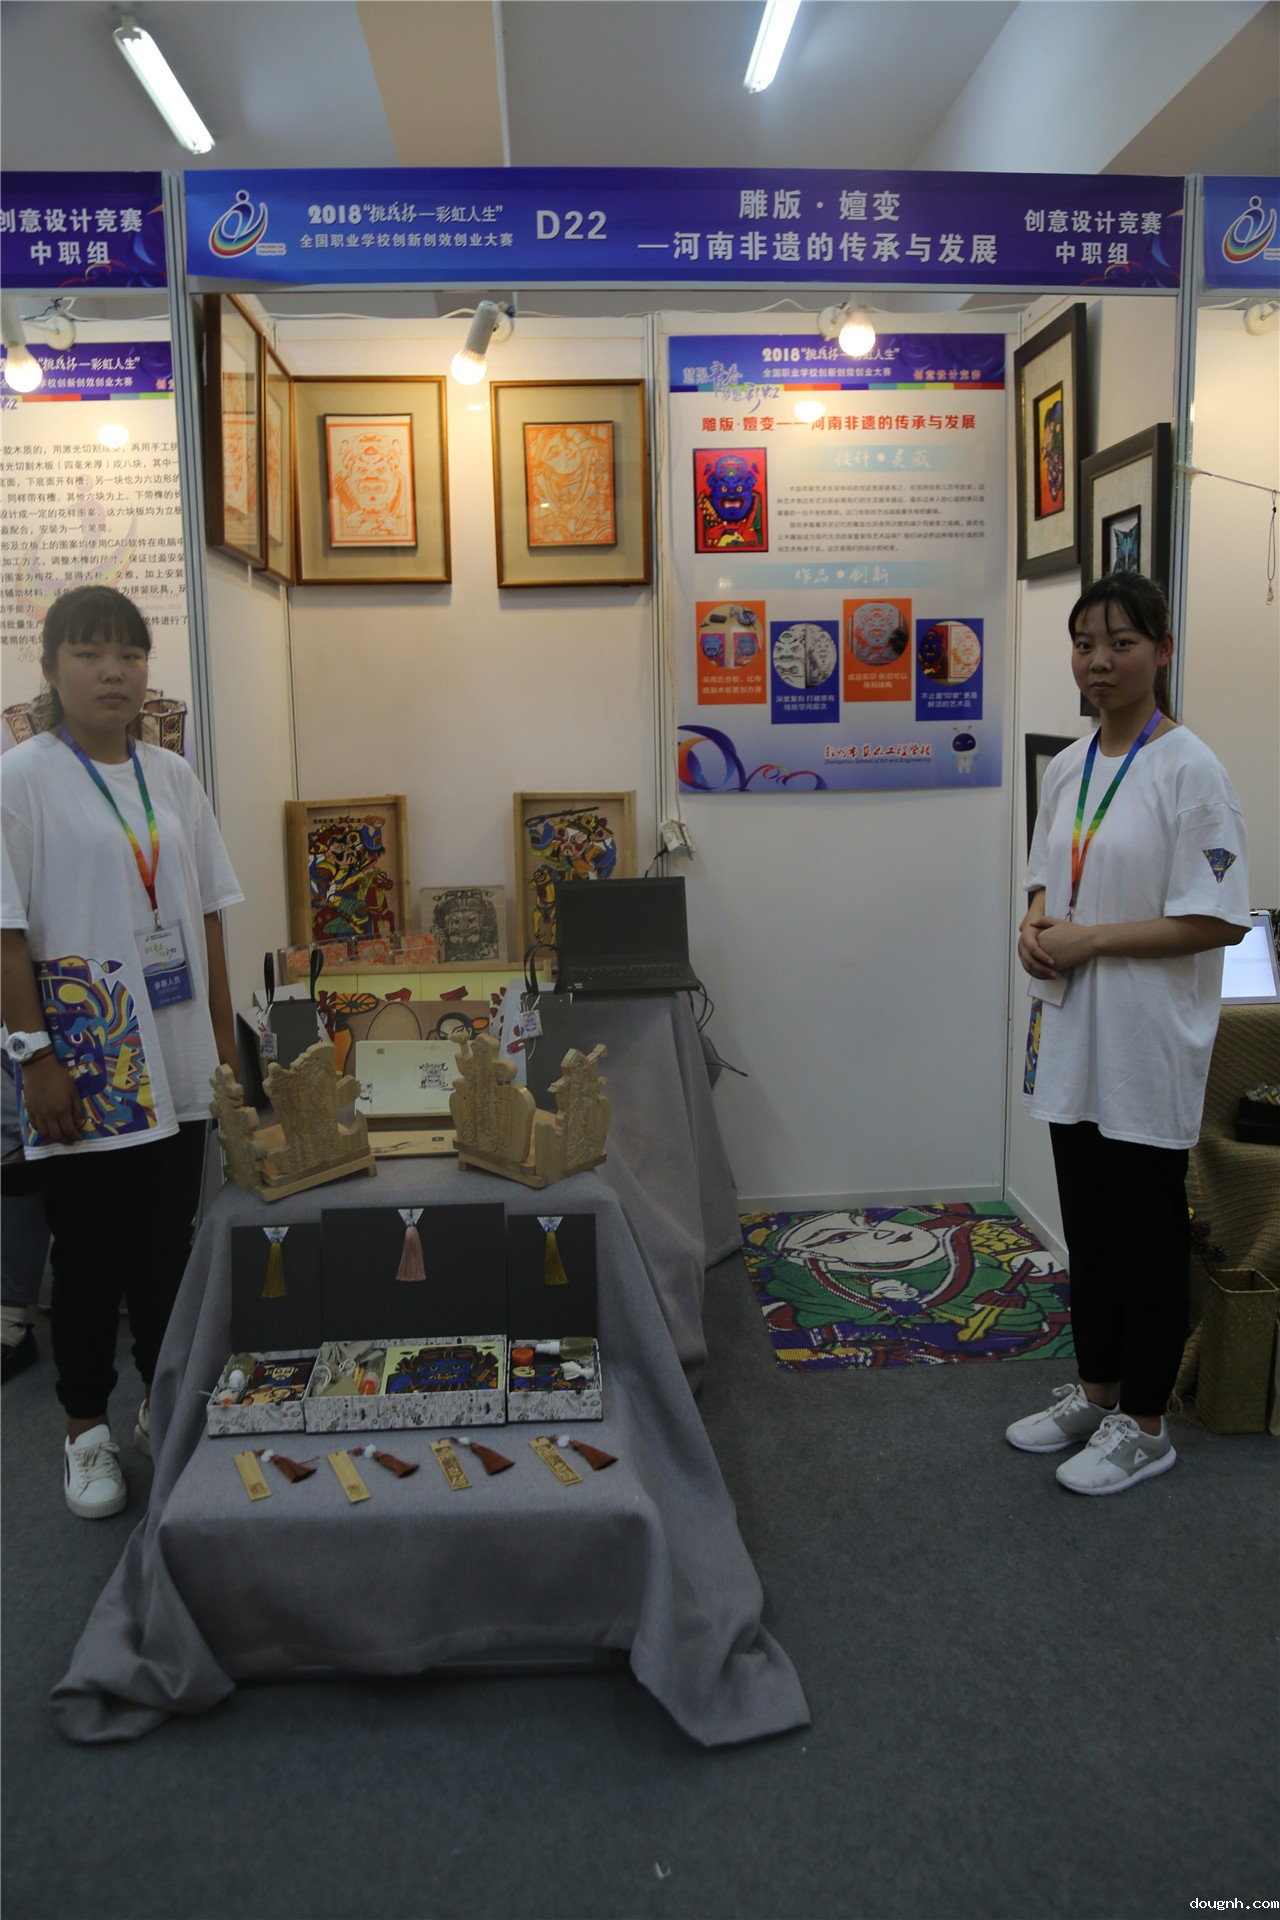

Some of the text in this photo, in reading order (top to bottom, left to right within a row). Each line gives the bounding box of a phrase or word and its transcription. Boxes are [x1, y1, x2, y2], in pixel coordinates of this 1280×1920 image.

[0, 208, 143, 233] 创意设计竞赛
[536, 210, 608, 241] D22
[1024, 209, 1162, 235] 创意设计竞赛
[300, 232, 513, 248] 全国职业学校创新创效创业大赛
[1056, 240, 1129, 265] 中职组
[30, 240, 111, 266] 中职组
[763, 367, 892, 378] 全国职业学校创新创效创业大赛
[913, 369, 981, 381] 创意设计竞赛
